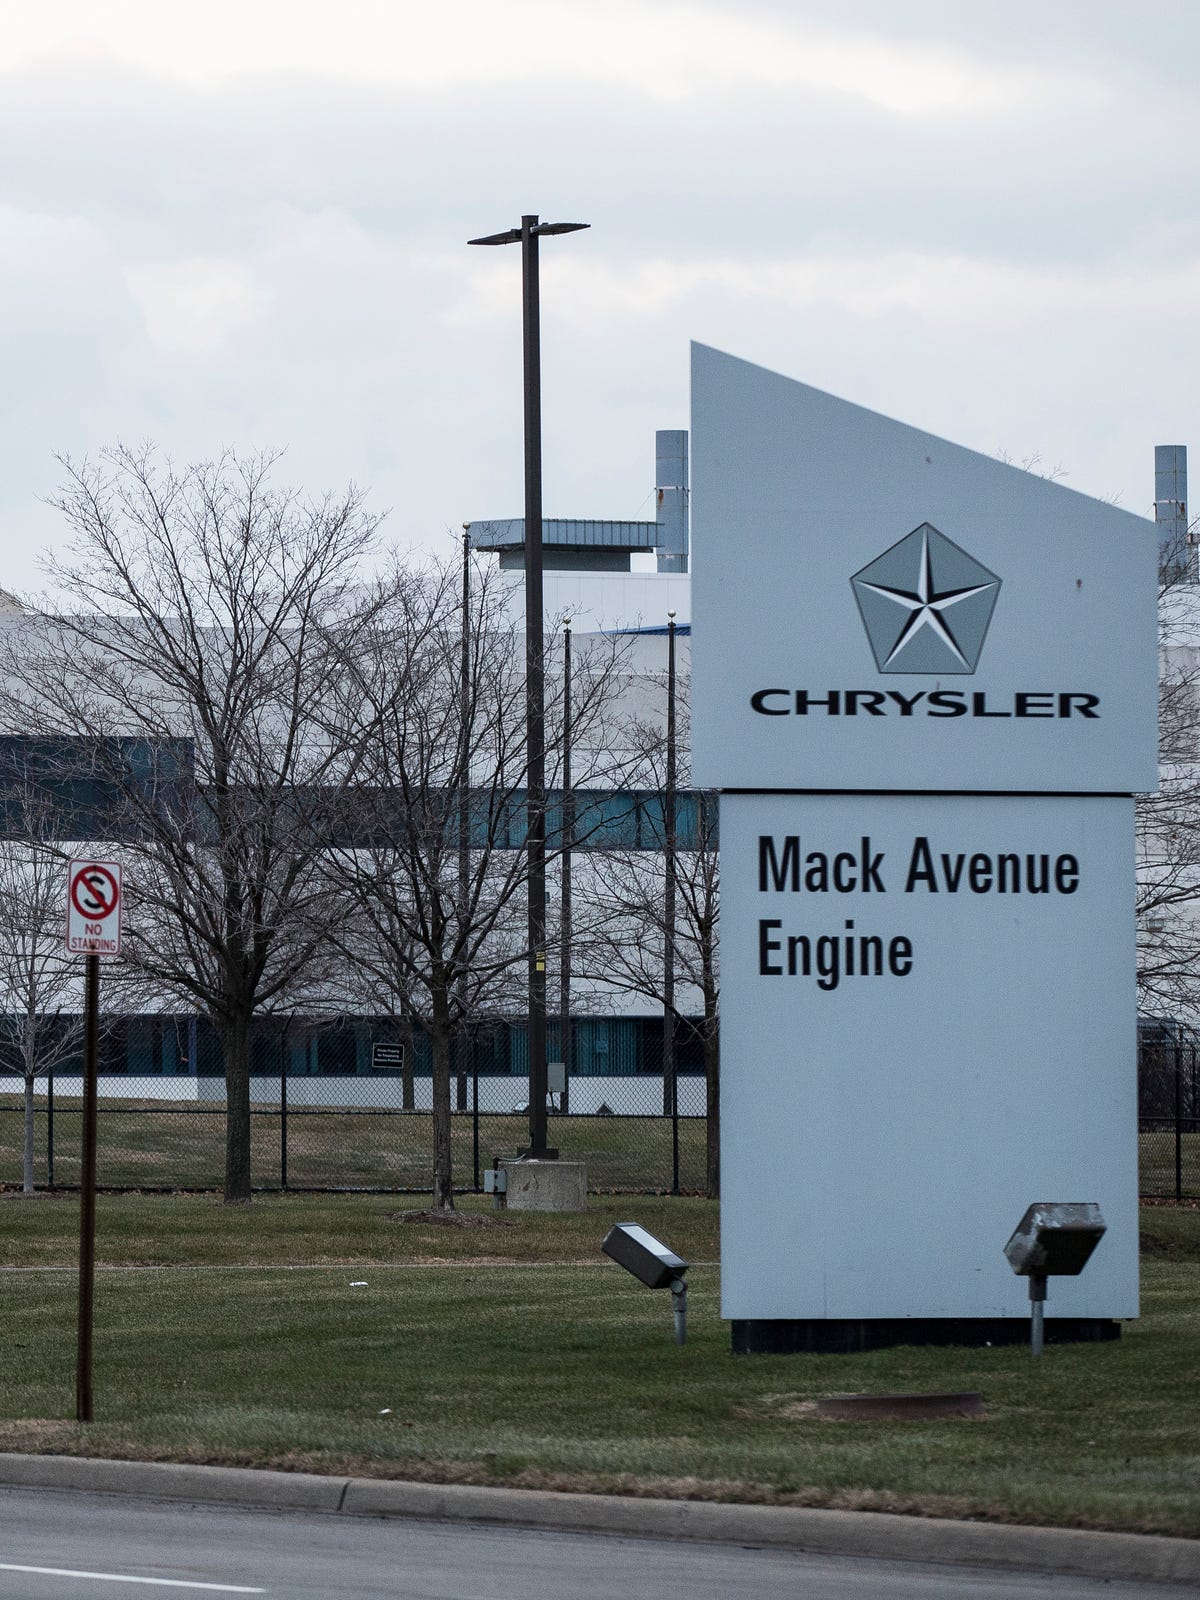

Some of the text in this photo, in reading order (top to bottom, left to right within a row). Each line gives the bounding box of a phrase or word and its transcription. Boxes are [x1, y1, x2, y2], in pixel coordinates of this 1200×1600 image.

[750, 688, 1101, 719] CHRYSLER
[757, 834, 1080, 895] Mack Avenue
[71, 937, 116, 951] STANDING
[85, 924, 102, 935] NO
[757, 919, 914, 991] Engine
